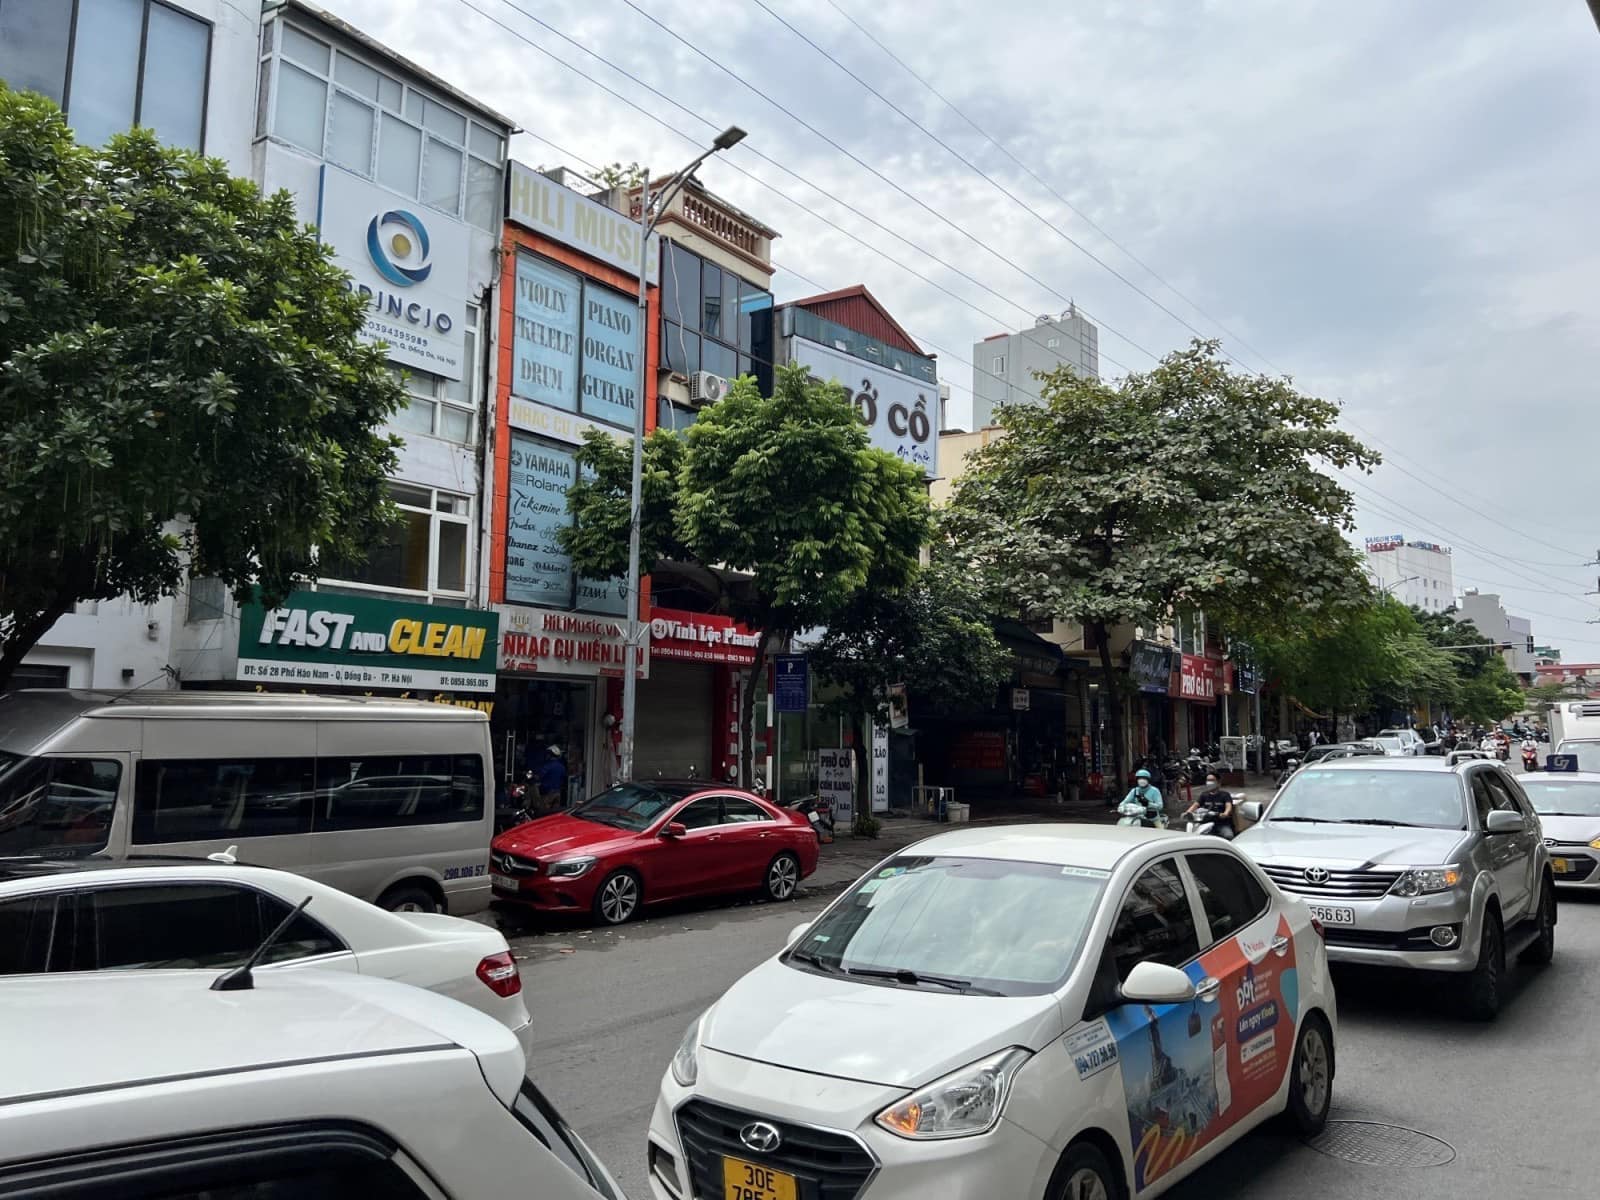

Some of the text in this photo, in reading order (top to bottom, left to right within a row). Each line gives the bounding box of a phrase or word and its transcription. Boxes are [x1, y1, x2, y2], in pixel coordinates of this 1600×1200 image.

[511, 170, 565, 233] HILI
[343, 280, 452, 334] INCIO
[520, 276, 567, 313] VIOLIN
[588, 300, 632, 335] PIANO
[517, 316, 573, 356] KULELE
[584, 337, 635, 372] ORGAN
[521, 358, 563, 391] DRUM
[582, 374, 635, 410] GUITAR
[525, 452, 570, 479] YAMAHA
[526, 473, 567, 494] Roland
[512, 487, 561, 515] Takamine
[507, 554, 525, 567] ORG
[259, 607, 487, 659] FAST AND CLEAN
[698, 624, 721, 647] Lộc
[503, 632, 550, 660] NHẠC
[554, 638, 575, 663] CỤ
[614, 643, 644, 666] LIN
[257, 664, 268, 676] Số
[270, 667, 279, 677] 28
[312, 669, 329, 679] Nam
[381, 673, 390, 683] TP.
[1182, 668, 1195, 696] PHỞ
[1554, 755, 1570, 770] G7
[1310, 906, 1351, 922] 566.63
[743, 1165, 775, 1193] 30E
